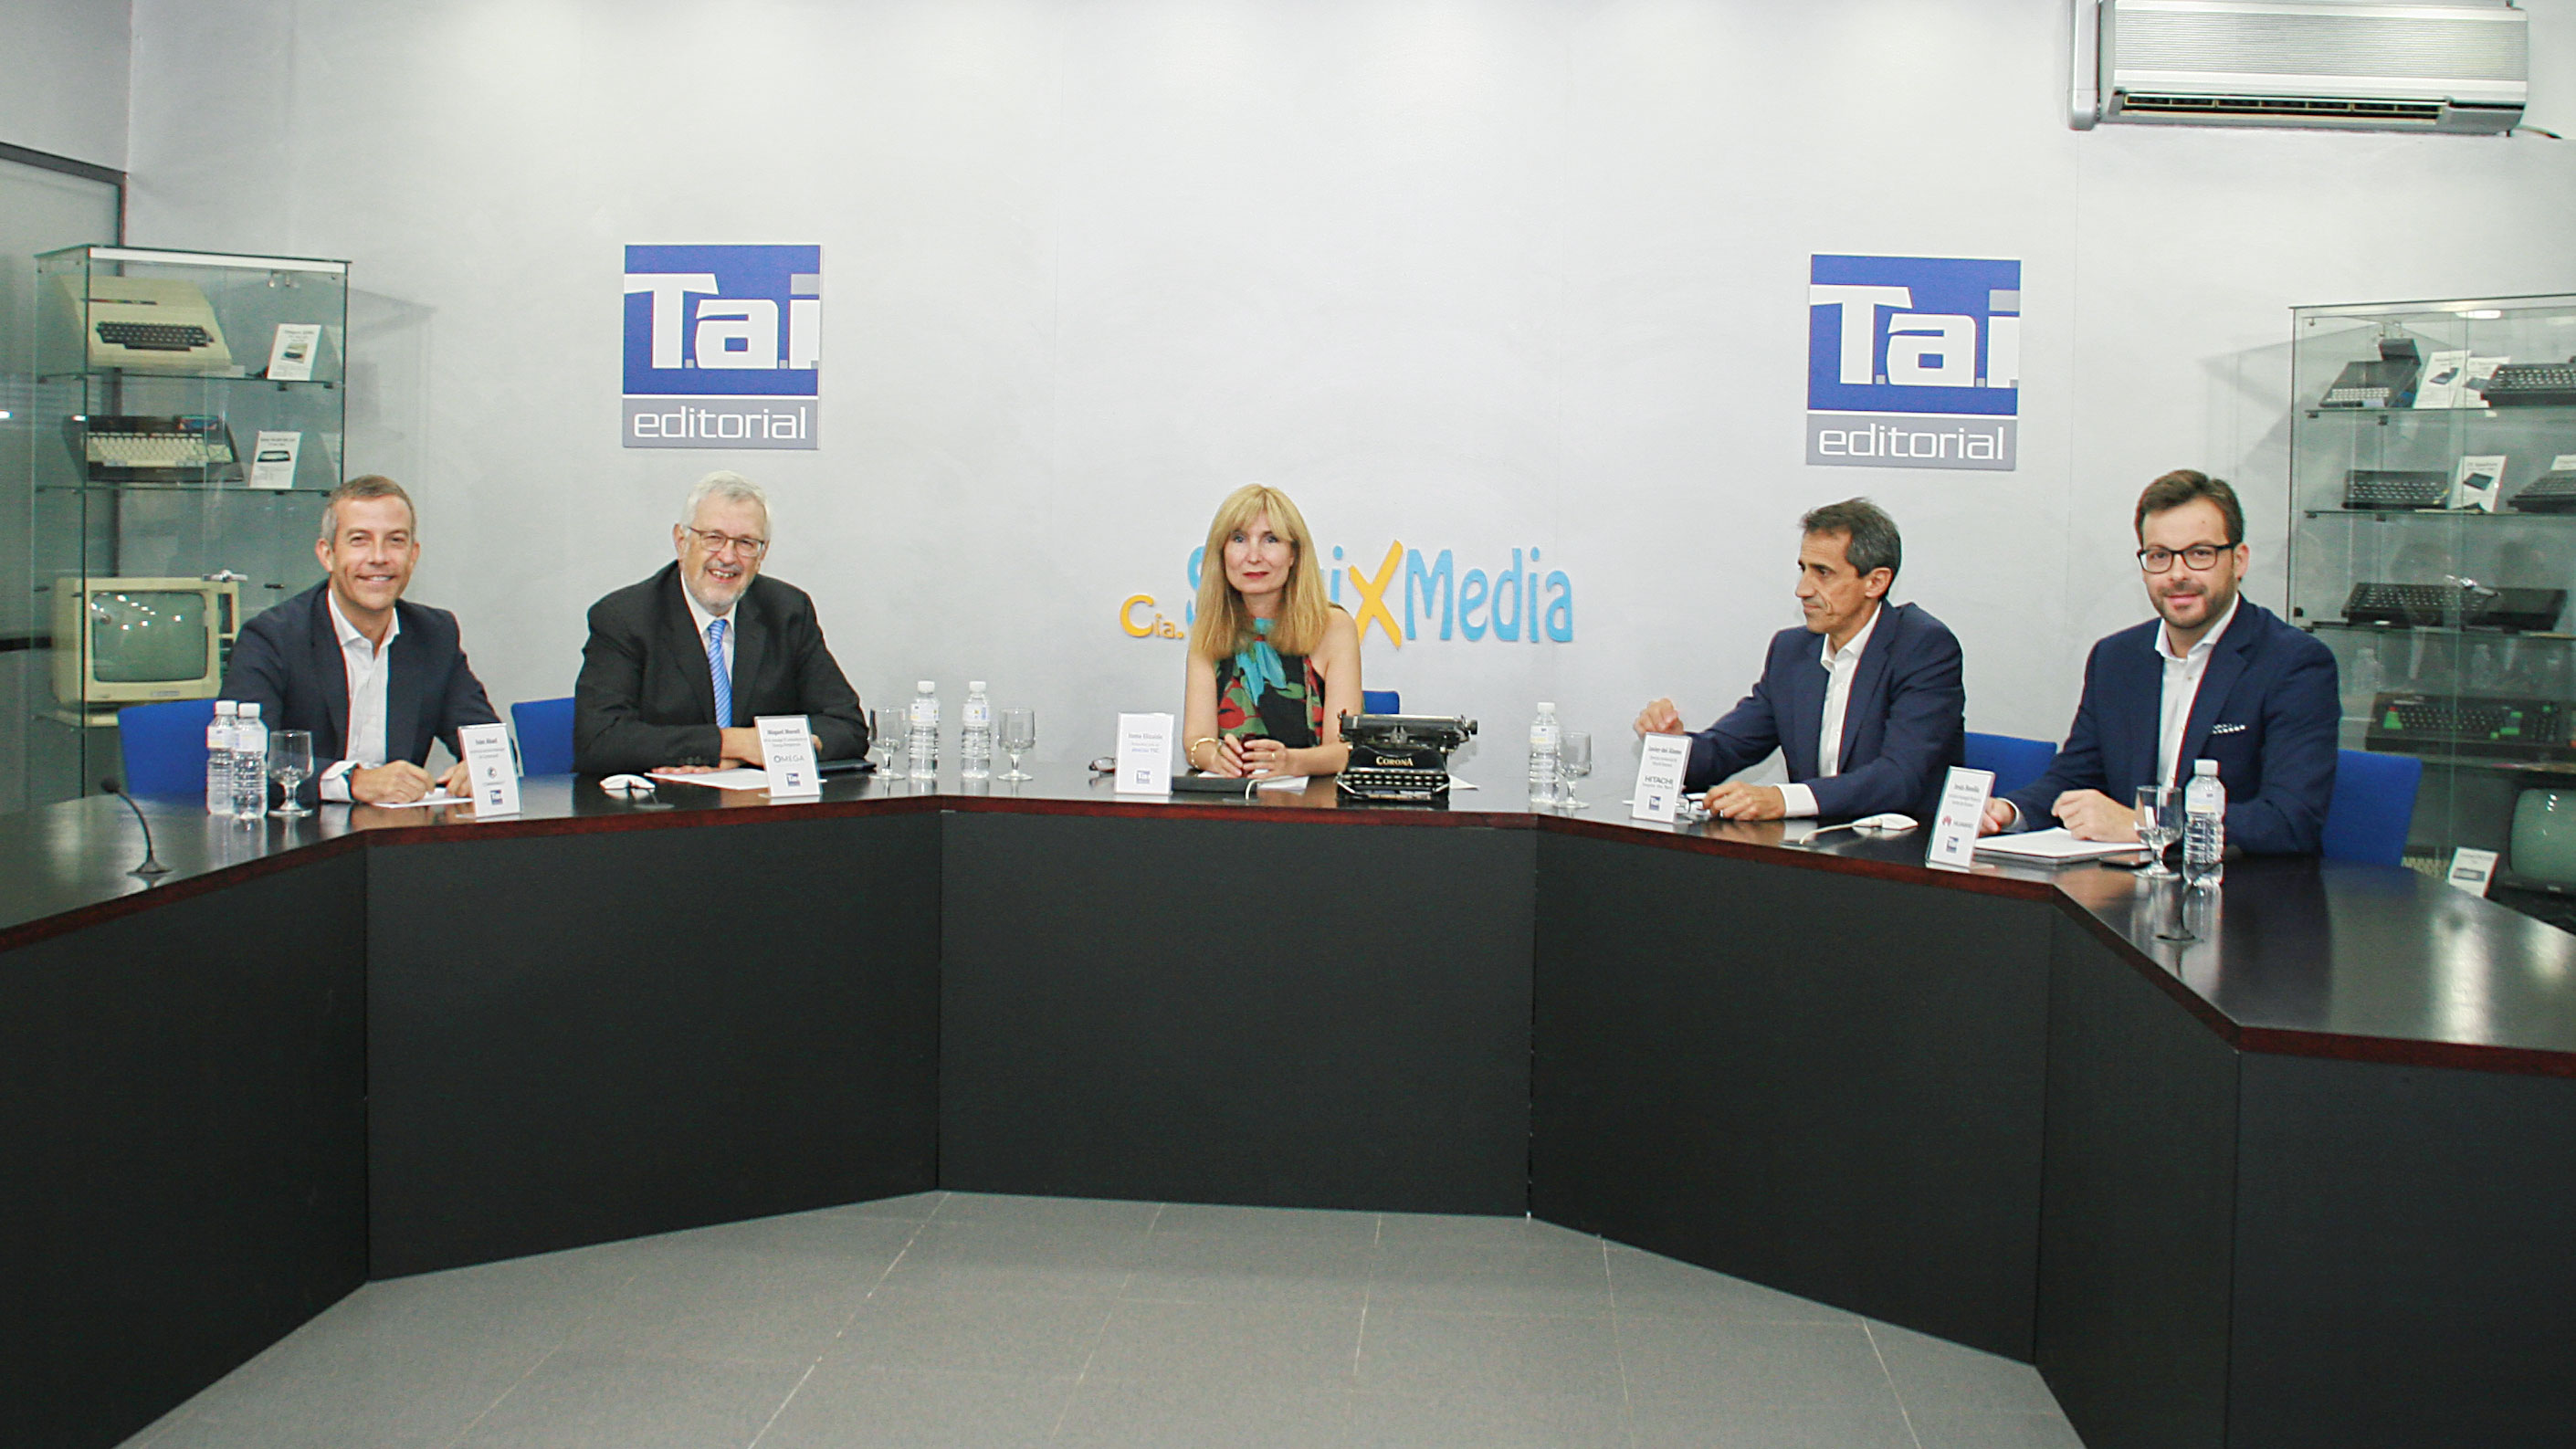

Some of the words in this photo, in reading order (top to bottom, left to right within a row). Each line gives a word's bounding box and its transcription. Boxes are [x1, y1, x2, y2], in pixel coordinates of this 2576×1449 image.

[634, 405, 806, 439] editorial
[1818, 423, 2004, 460] editorial
[773, 755, 804, 763] OMEGA
[1375, 756, 1414, 767] CORONA
[1645, 775, 1674, 784] HITACHI
